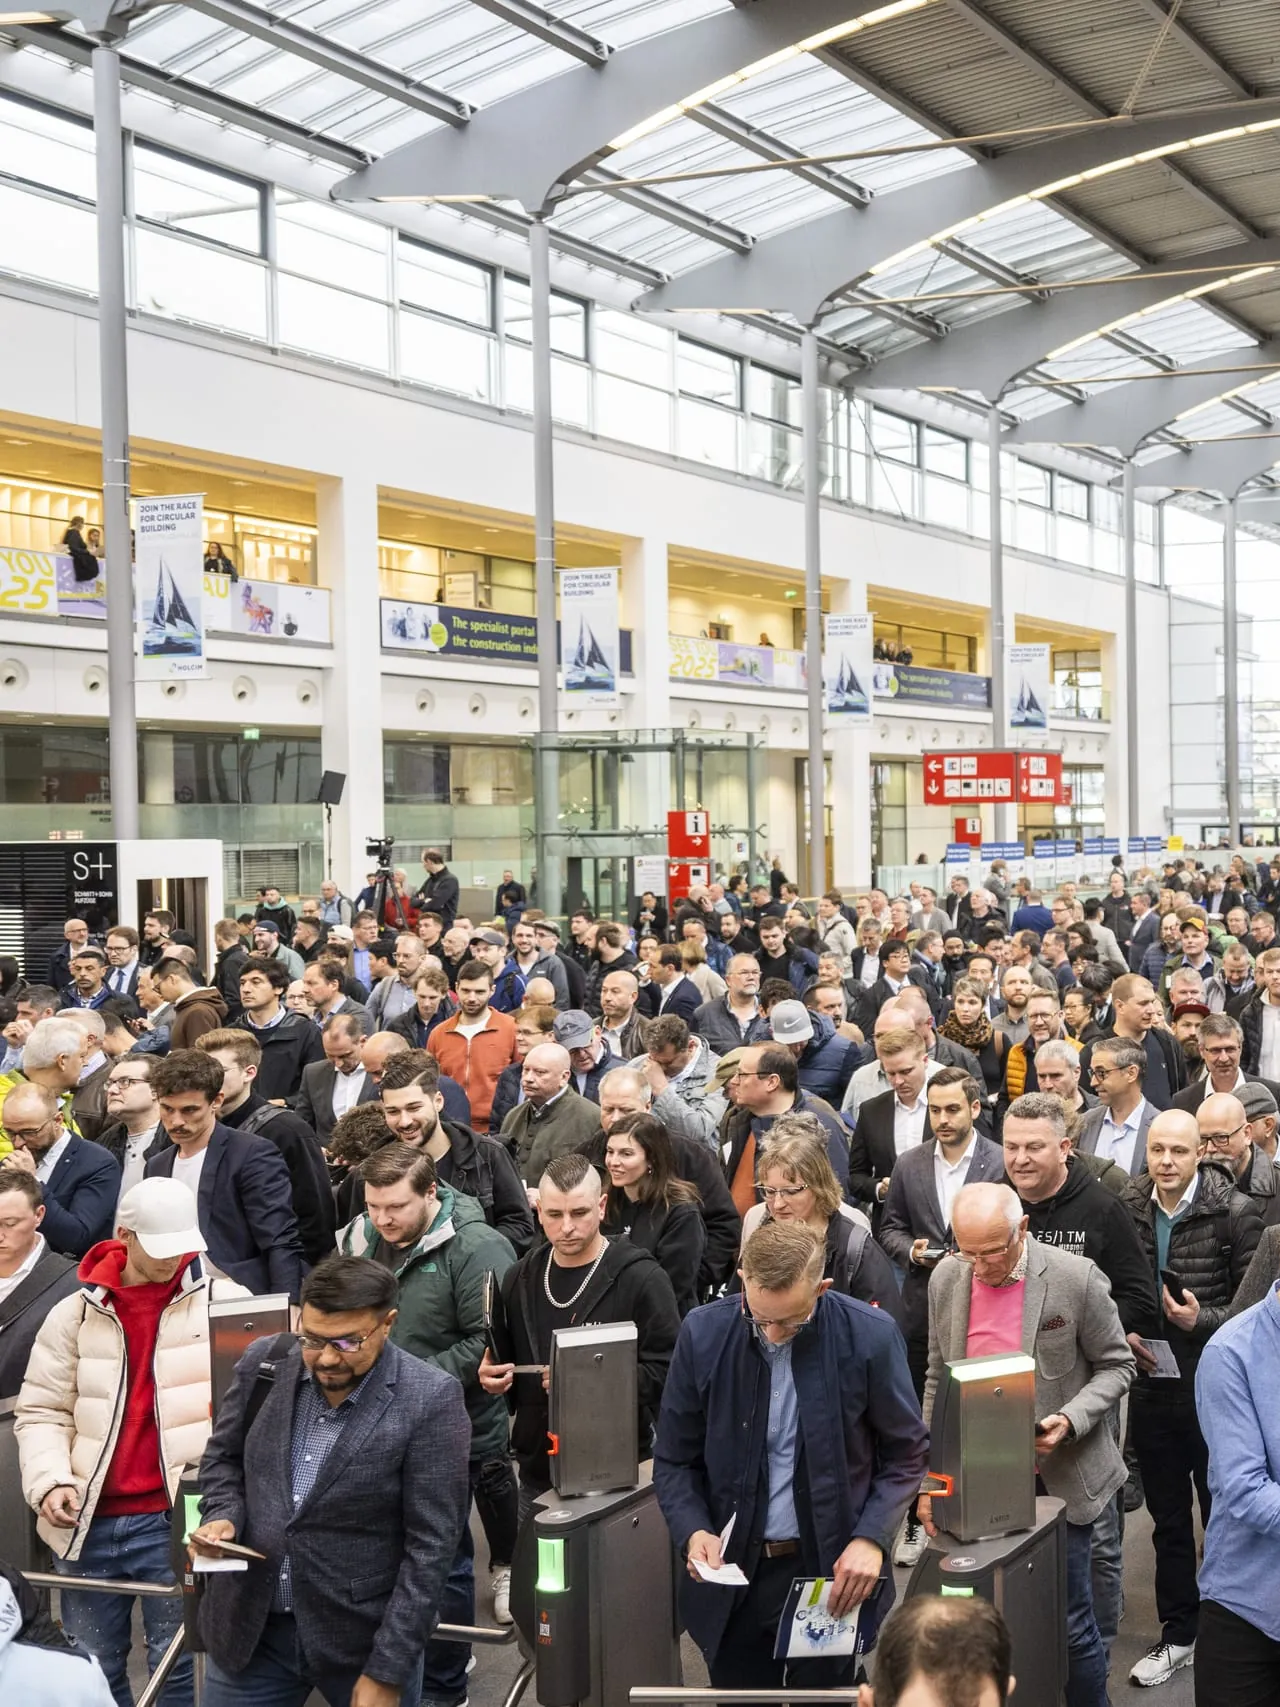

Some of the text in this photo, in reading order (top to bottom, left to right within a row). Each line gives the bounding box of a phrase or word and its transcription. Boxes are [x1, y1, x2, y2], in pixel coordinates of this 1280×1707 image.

[140, 502, 197, 513] JOIN THE RACE
[140, 512, 196, 523] FOR CIRCULAR
[141, 523, 176, 533] BUILDING
[0, 551, 53, 577] YOU
[0, 576, 55, 609] 25
[452, 616, 536, 637] The specialist portal
[452, 635, 468, 647] the
[469, 638, 521, 653] construction
[669, 655, 718, 678] 2025
[73, 852, 113, 880] S+
